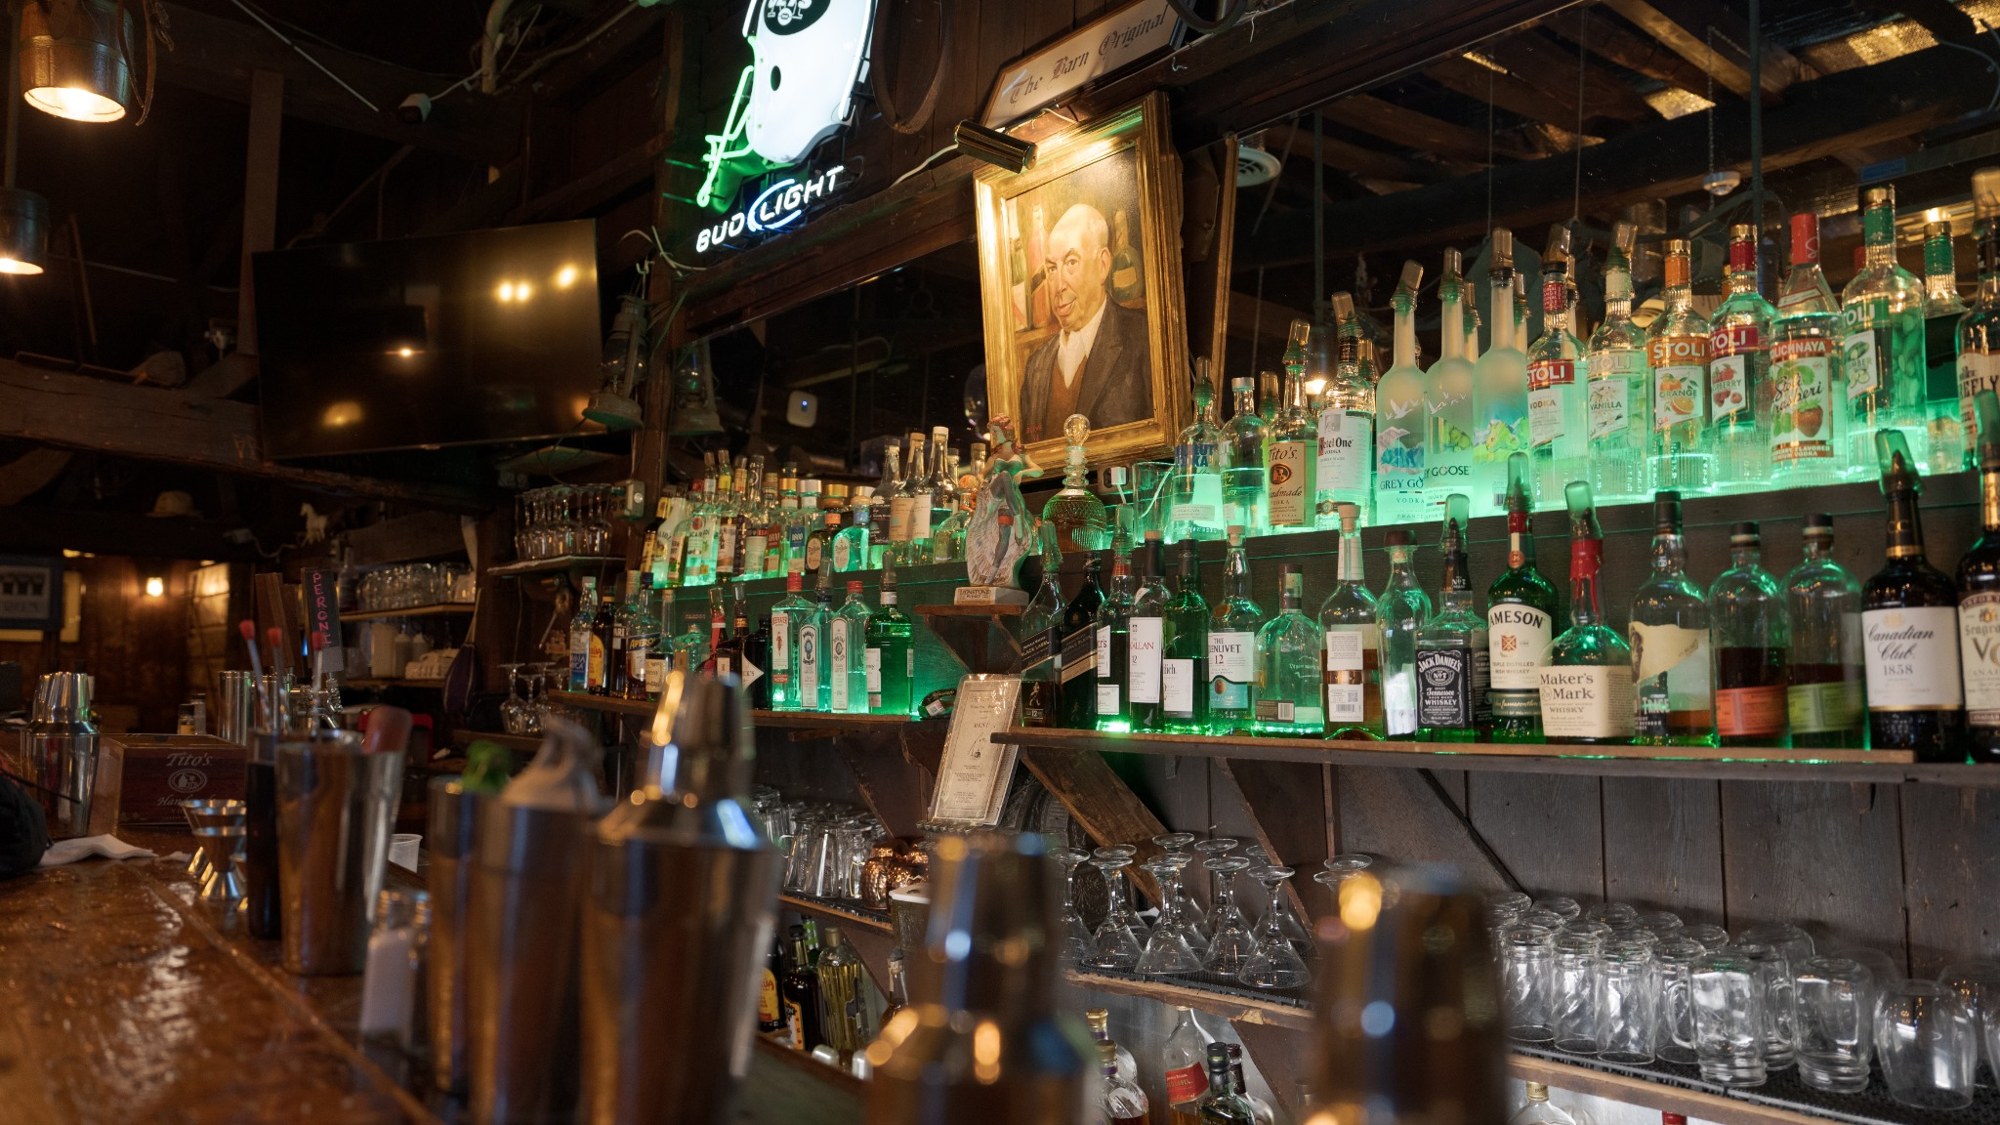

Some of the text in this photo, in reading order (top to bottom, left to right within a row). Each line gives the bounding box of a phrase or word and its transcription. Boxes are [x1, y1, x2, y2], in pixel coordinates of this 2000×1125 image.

[1010, 4, 1169, 104] The Barn Original
[696, 165, 844, 252] BUD LIGHT
[1710, 330, 1746, 352] TOLI
[1653, 342, 1705, 359] STOLI
[1659, 389, 1698, 399] ORANGE
[1590, 401, 1622, 411] VANILLA
[1335, 436, 1354, 448] One
[1431, 465, 1470, 477] GOOSE
[1380, 479, 1404, 490] GREY
[1490, 610, 1543, 629] AMESON
[1868, 623, 1934, 642] Canadian
[1209, 644, 1242, 654] ENLIVET
[1878, 643, 1918, 660] Club
[1215, 654, 1224, 664] 12
[1418, 654, 1463, 673] JACK DANIEL'S
[1883, 664, 1914, 676] 1858
[1540, 673, 1594, 685] Maker's
[1553, 688, 1595, 700] Mark
[1424, 699, 1457, 707] WHISKEY
[166, 752, 214, 767] Tito's
